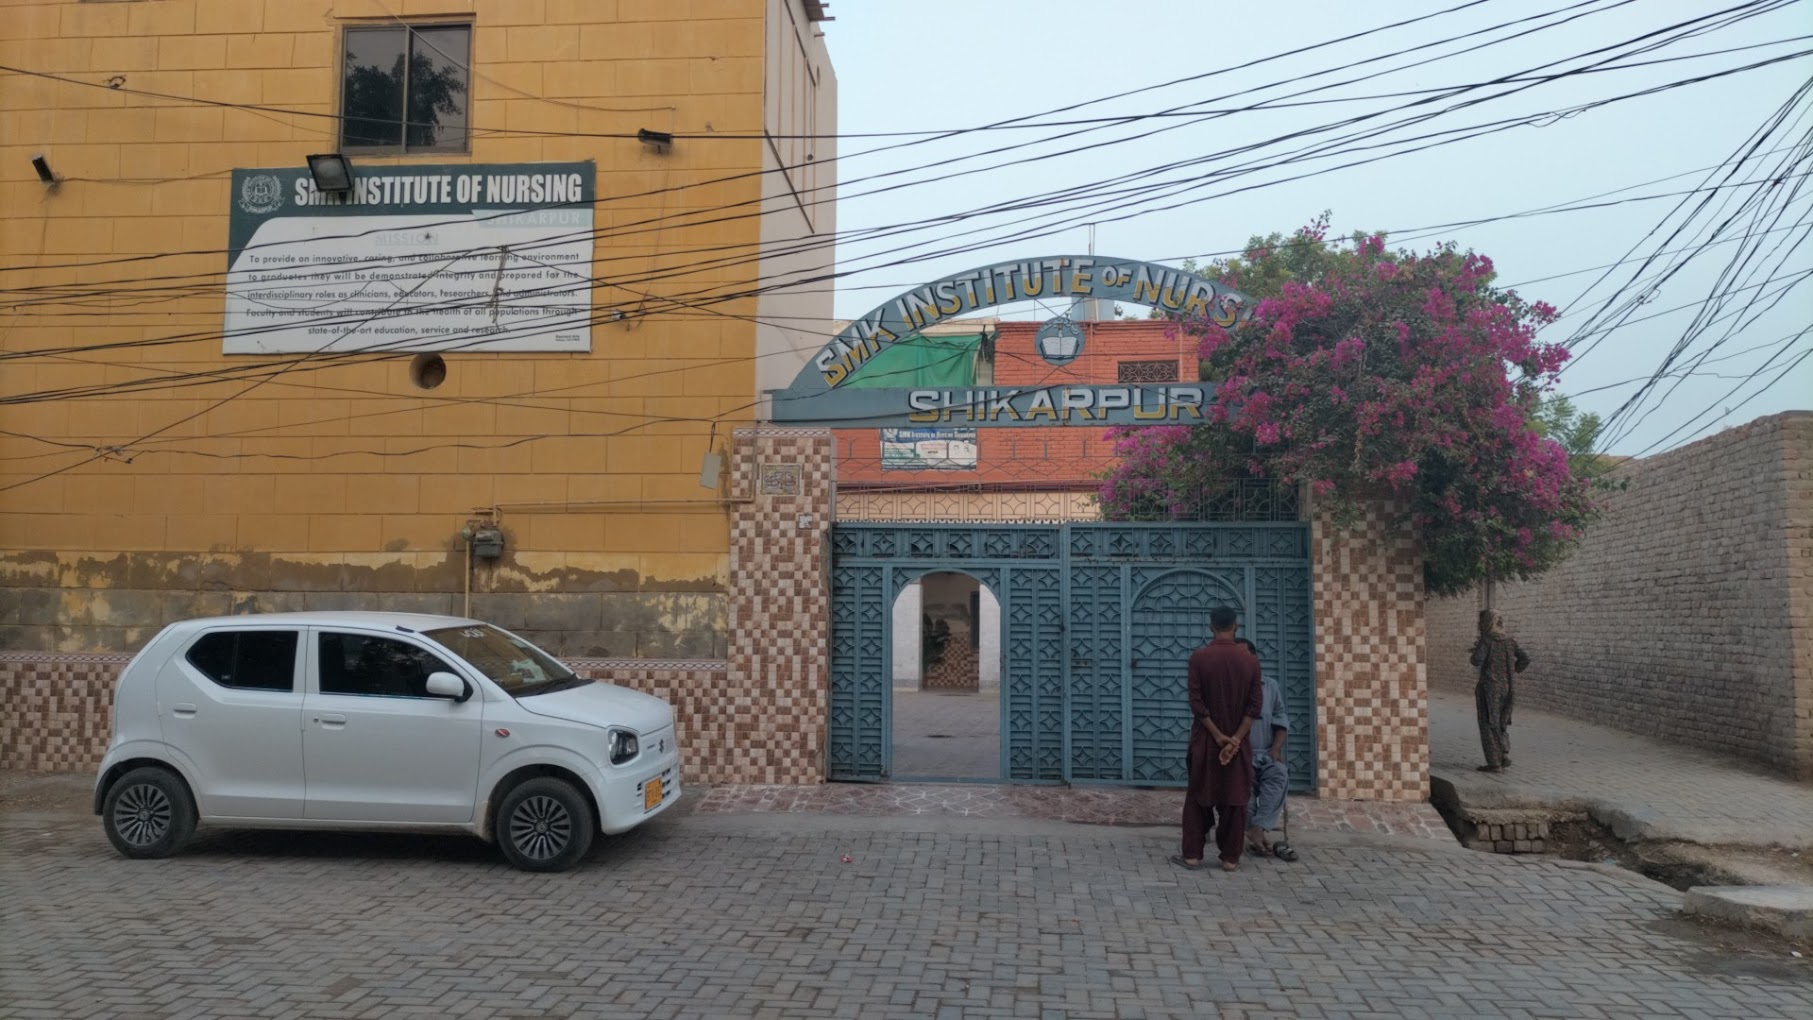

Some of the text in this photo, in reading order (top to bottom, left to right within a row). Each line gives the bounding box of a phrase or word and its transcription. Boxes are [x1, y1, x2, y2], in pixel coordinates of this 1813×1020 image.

[456, 174, 483, 204] OF
[486, 173, 582, 204] NURSING
[487, 212, 580, 225] SHIKARPUR
[375, 231, 439, 245] MISSION
[249, 255, 260, 263] To
[262, 254, 296, 265] provide
[480, 252, 519, 263] learnng
[521, 252, 580, 261] environment
[248, 273, 258, 281] to
[260, 272, 308, 283] graduates
[310, 272, 331, 282] they
[333, 271, 352, 280] will
[354, 271, 366, 280] be
[436, 271, 476, 281] integrity
[478, 270, 496, 280] and
[499, 270, 543, 281] prepared
[546, 270, 560, 279] for
[563, 270, 579, 279] the
[247, 289, 314, 301] interdisciplinary
[315, 289, 336, 299] roles
[338, 291, 348, 299] as
[350, 289, 391, 299] clinicians,
[246, 308, 276, 319] Faculty
[278, 308, 295, 317] and
[297, 307, 334, 317] students
[336, 306, 353, 317] will
[463, 307, 473, 316] of
[474, 307, 487, 316] all
[489, 307, 540, 318] populations
[542, 307, 579, 317] through
[815, 258, 1253, 389] SMK INSTITUTE OF NURSI
[307, 326, 372, 336] state-of-the-art
[374, 325, 419, 336] education,
[420, 325, 451, 335] service
[452, 325, 469, 334] and
[908, 387, 1204, 424] SHIKARPUR
